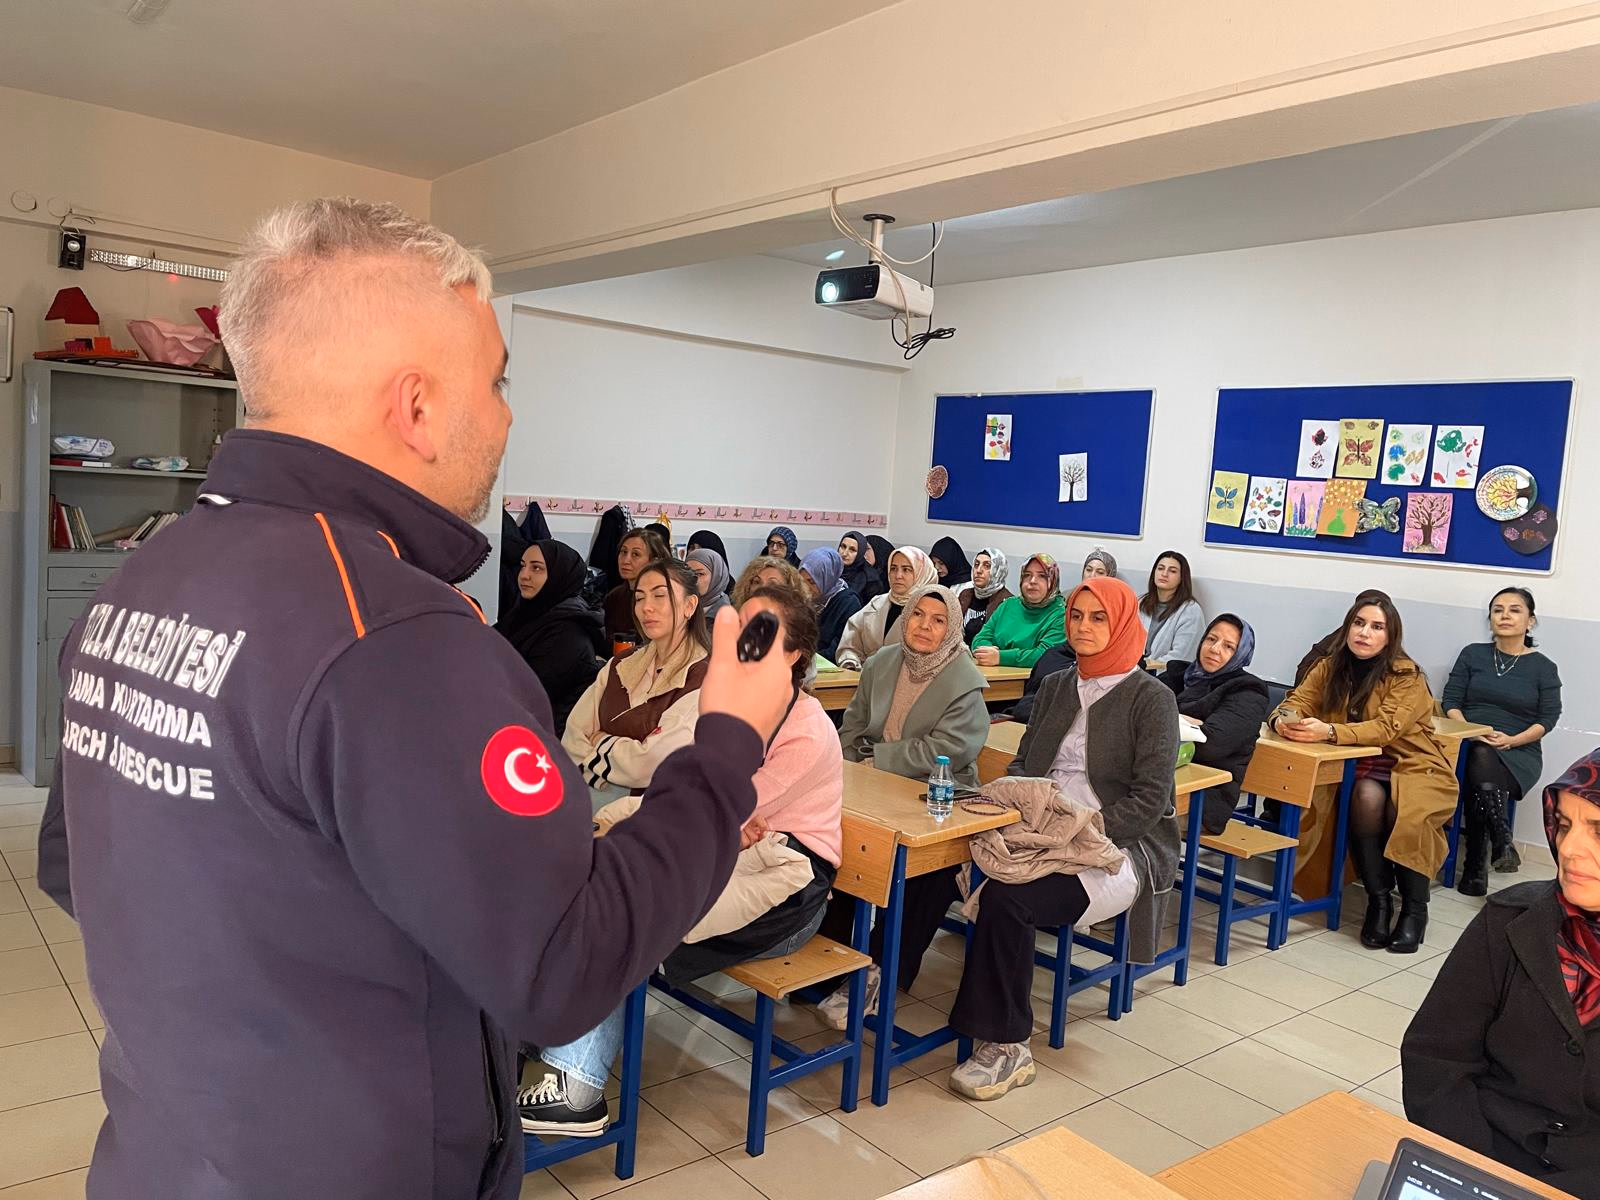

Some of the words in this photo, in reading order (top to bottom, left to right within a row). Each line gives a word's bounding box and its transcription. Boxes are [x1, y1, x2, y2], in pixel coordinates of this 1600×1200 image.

[112, 611, 247, 698] BELEDİYESİ
[110, 681, 212, 748] KURTARMA
[116, 741, 215, 800] RESCUE
